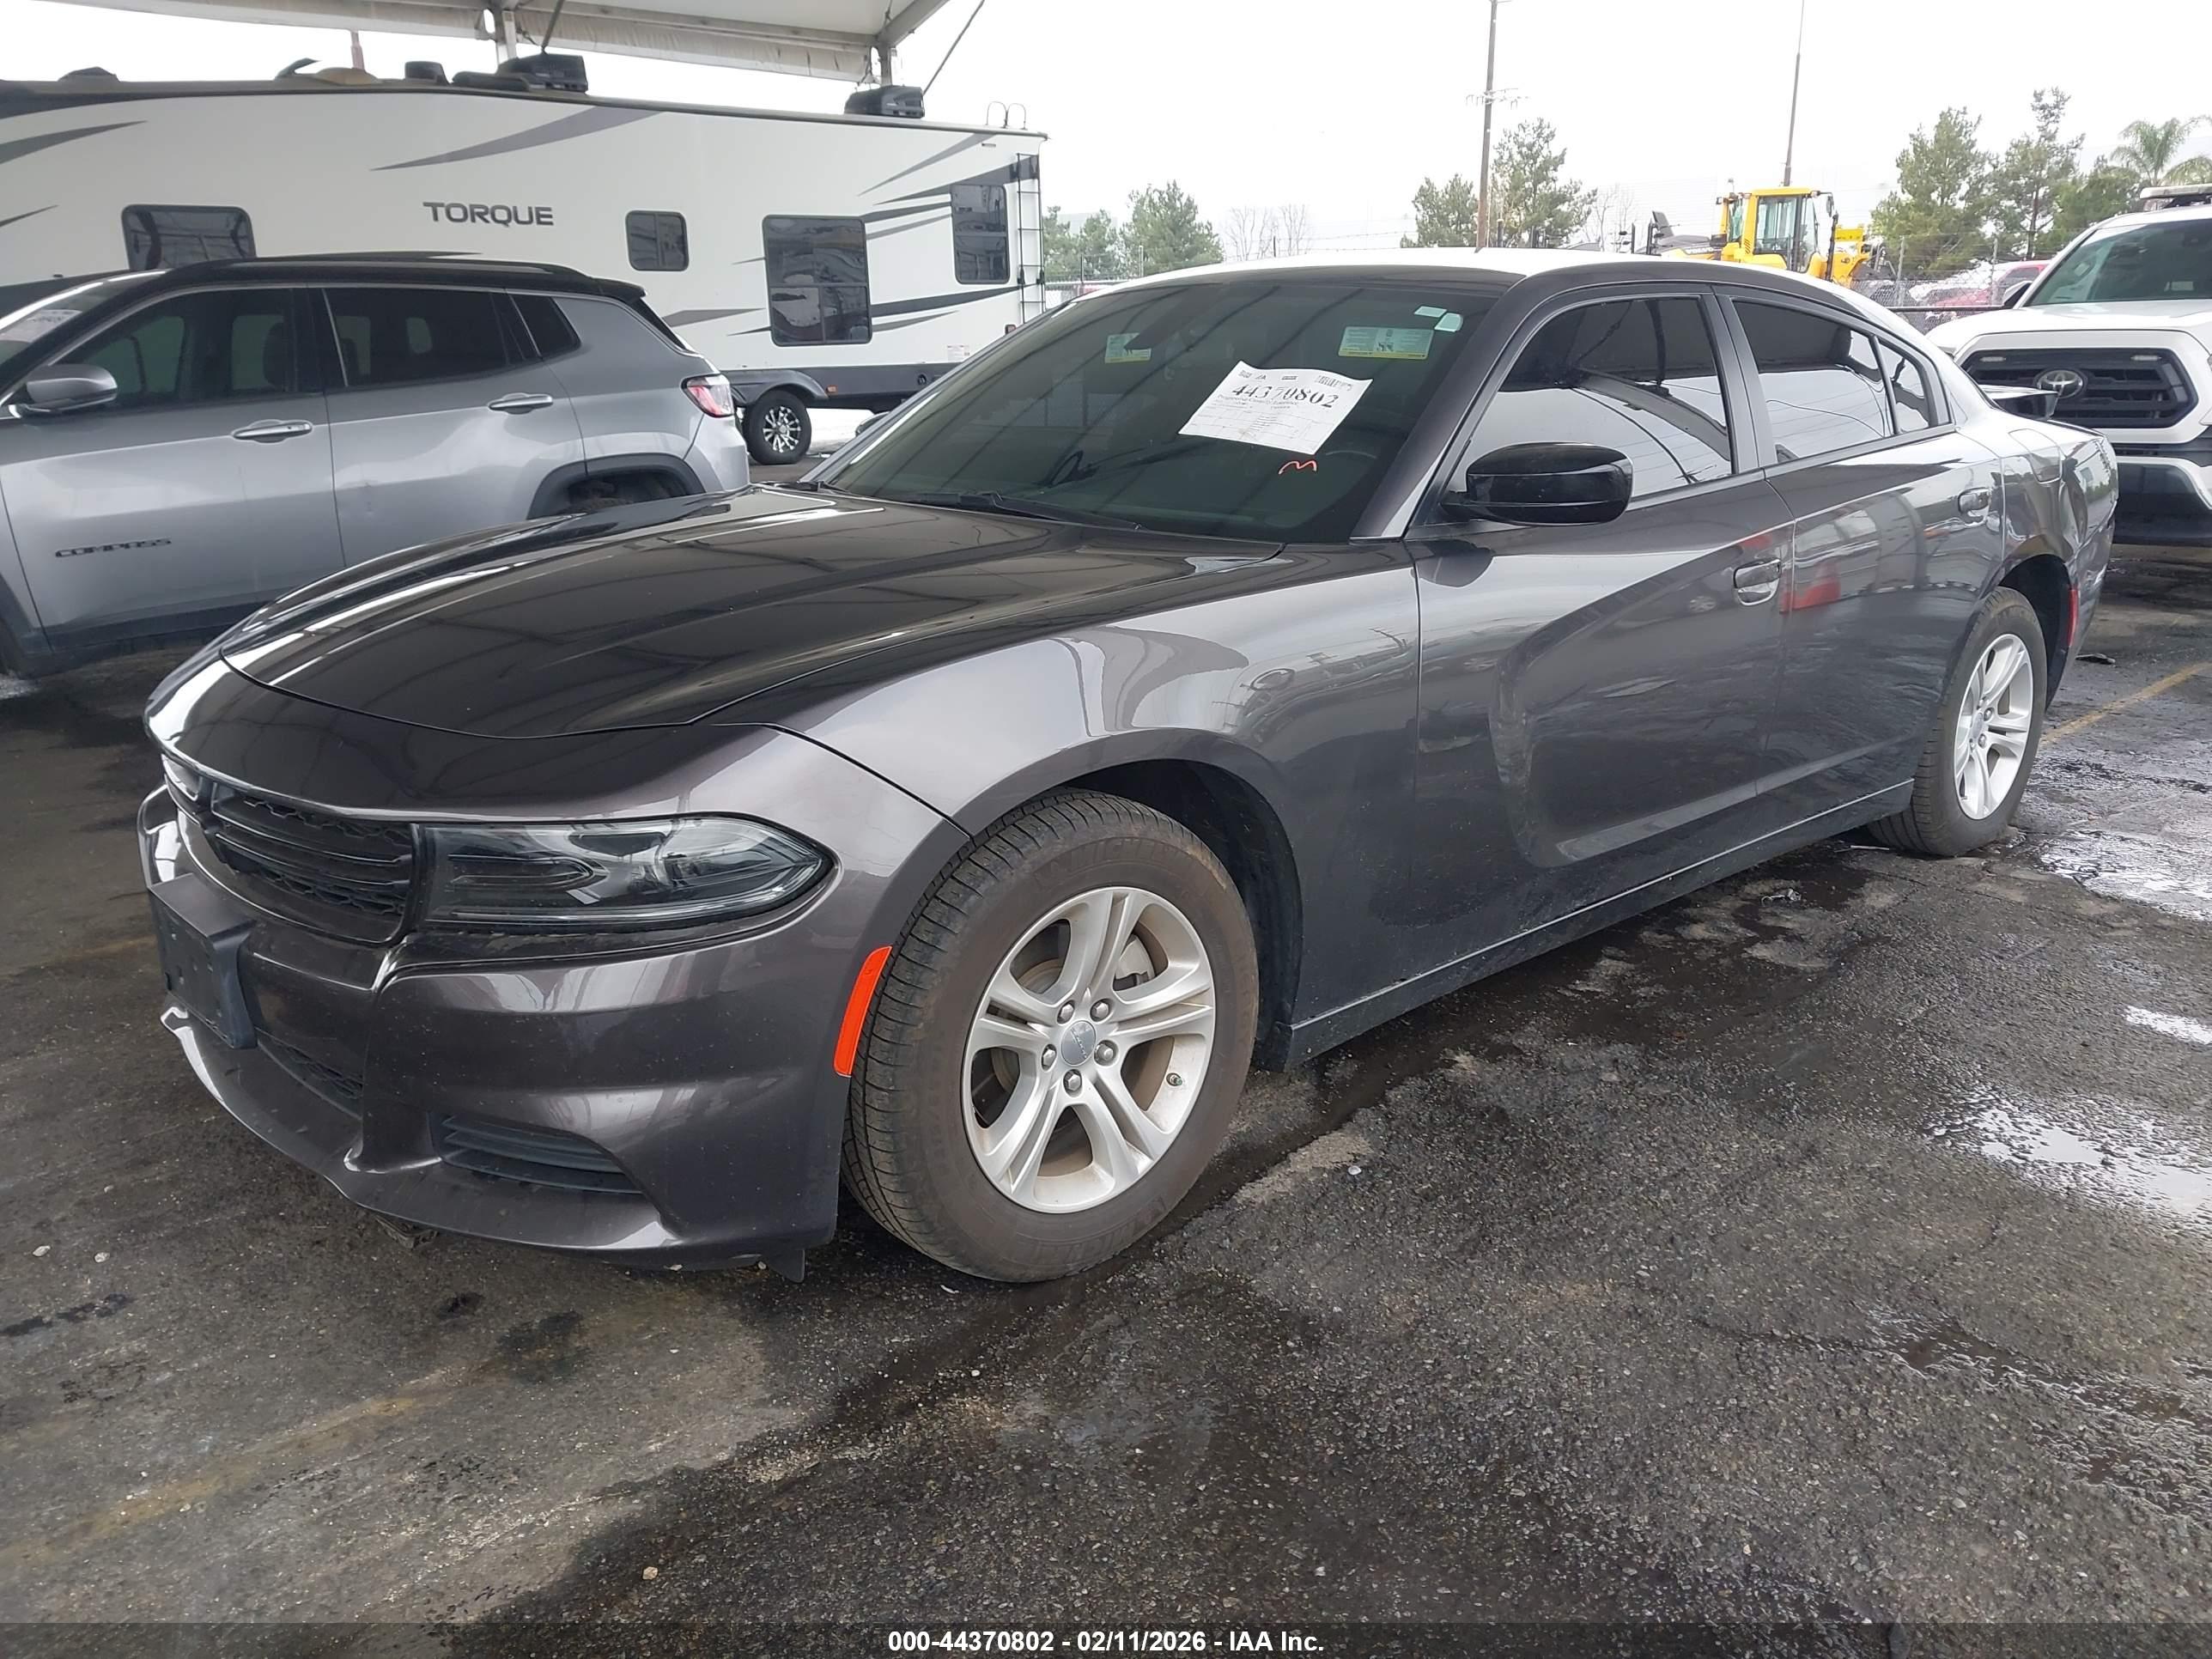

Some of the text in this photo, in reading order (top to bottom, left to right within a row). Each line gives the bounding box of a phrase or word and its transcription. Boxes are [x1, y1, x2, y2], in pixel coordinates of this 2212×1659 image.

[422, 201, 555, 228] TORQUE
[1231, 384, 1340, 409] 44370802
[55, 538, 173, 558] COMPASS
